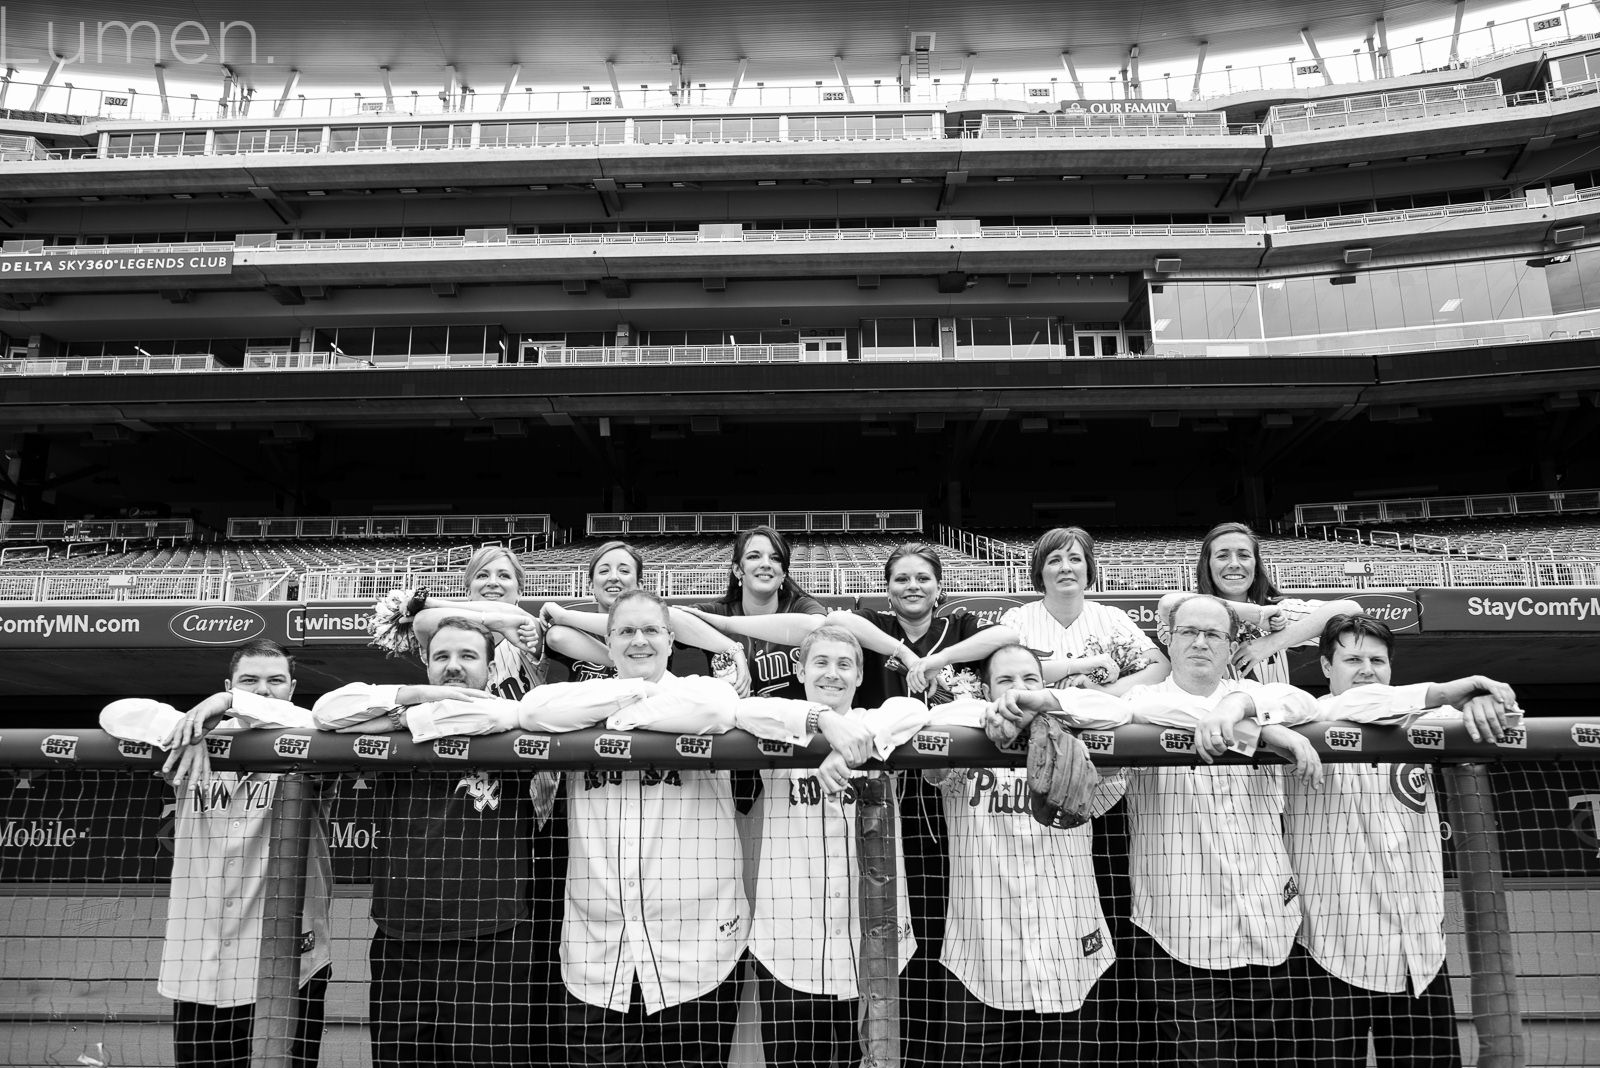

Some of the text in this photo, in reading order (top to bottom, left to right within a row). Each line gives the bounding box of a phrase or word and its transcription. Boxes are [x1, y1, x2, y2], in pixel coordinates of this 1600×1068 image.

[1538, 17, 1560, 29] 313
[1301, 65, 1319, 74] 312
[108, 97, 128, 106] 307
[1091, 100, 1171, 114] OUR FAMILY
[1, 261, 53, 272] DELTA
[189, 256, 227, 269] CLUB
[1363, 563, 1372, 574] 6
[127, 575, 136, 585] 4
[0, 615, 140, 638] omfyMN.com
[182, 614, 254, 632] Carrier
[1081, 733, 1113, 743] BEST
[1330, 730, 1361, 739] BEST
[1412, 729, 1443, 738] BEST
[47, 738, 77, 748] BEST
[279, 738, 310, 748] BEST
[358, 738, 388, 748] BEST
[440, 738, 469, 748] BEST
[518, 738, 549, 748] BEST
[600, 738, 630, 747] BEST
[681, 737, 711, 747] BEST
[917, 734, 948, 744] BEST
[1331, 738, 1358, 747] BUY
[1413, 736, 1441, 746] BUY
[46, 745, 73, 755] BUY
[123, 745, 149, 755] BUY
[209, 745, 230, 756] UY
[278, 745, 306, 755] BUY
[358, 745, 386, 755] BUY
[439, 745, 466, 755] BUY
[518, 745, 546, 755] BUY
[599, 745, 627, 755] BUY
[680, 744, 708, 754] BUY
[763, 743, 790, 753] BUY
[917, 741, 945, 751] BUY
[193, 780, 231, 813] NW
